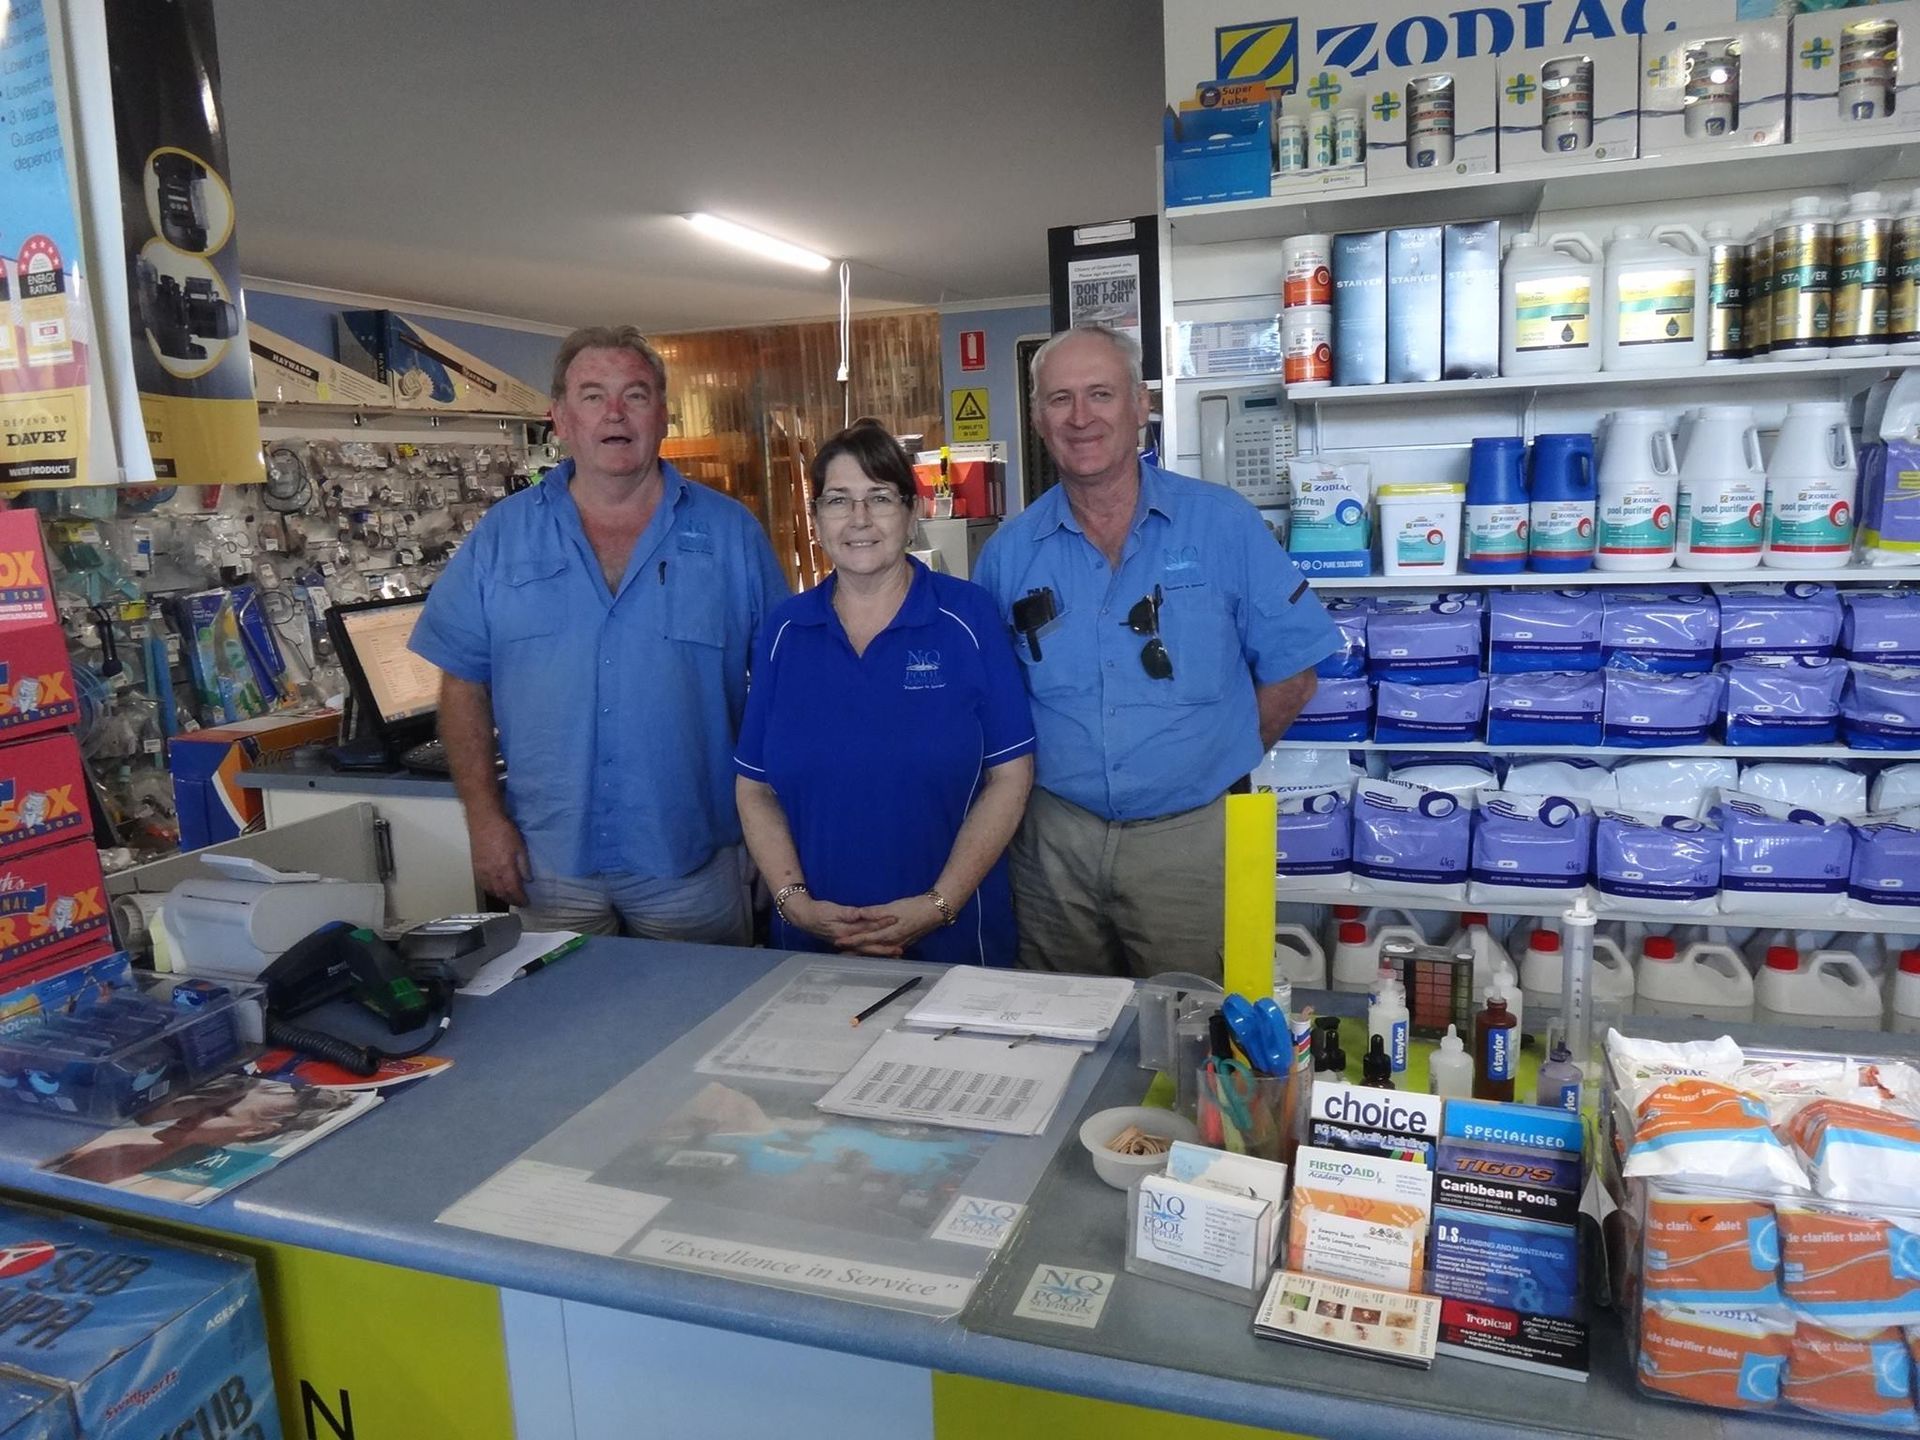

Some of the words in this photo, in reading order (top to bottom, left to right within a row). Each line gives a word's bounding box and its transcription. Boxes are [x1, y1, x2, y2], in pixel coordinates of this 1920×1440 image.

[1222, 86, 1253, 97] Super
[1221, 97, 1248, 106] Lube
[27, 271, 56, 285] ENERGY
[1111, 278, 1136, 293] SINK
[1336, 277, 1382, 289] STARVER
[1391, 274, 1438, 285] STARVER
[29, 282, 57, 294] RATING
[1076, 294, 1099, 307] OUR
[272, 353, 313, 377] HAYWARD
[3, 416, 47, 427] DEPEND
[6, 430, 67, 446] DAVEY
[1314, 484, 1353, 492] ZODIAC
[1395, 1026, 1407, 1060] taylor
[1494, 1033, 1505, 1066] taylor
[1324, 1090, 1428, 1134] choice
[1351, 1129, 1387, 1143] Quality
[1464, 1124, 1565, 1148] SPECIALISED
[1308, 1170, 1345, 1186] Academy
[1309, 1160, 1341, 1172] FIRST
[1353, 1168, 1375, 1178] AID
[1455, 1156, 1556, 1183] TIGO'S
[1440, 1178, 1514, 1200] Caribbean
[1517, 1190, 1558, 1207] Pools
[962, 1200, 1018, 1222] NQ
[1144, 1192, 1187, 1220] NQ
[1144, 1215, 1185, 1235] POOL
[1802, 1232, 1848, 1243] clarifier
[1848, 1231, 1882, 1243] tablet
[1459, 1237, 1496, 1250] PLUMBING
[1496, 1243, 1512, 1252] AND
[1512, 1245, 1565, 1261] MAINTENANCE
[805, 1263, 833, 1280] in
[837, 1267, 938, 1297] Service
[1042, 1268, 1105, 1295] NQ
[1033, 1290, 1095, 1308] POOL
[204, 1303, 235, 1332] AGES
[1465, 1313, 1512, 1331] Tropical
[1664, 1336, 1704, 1353] clarifier
[1706, 1345, 1738, 1360] tablet
